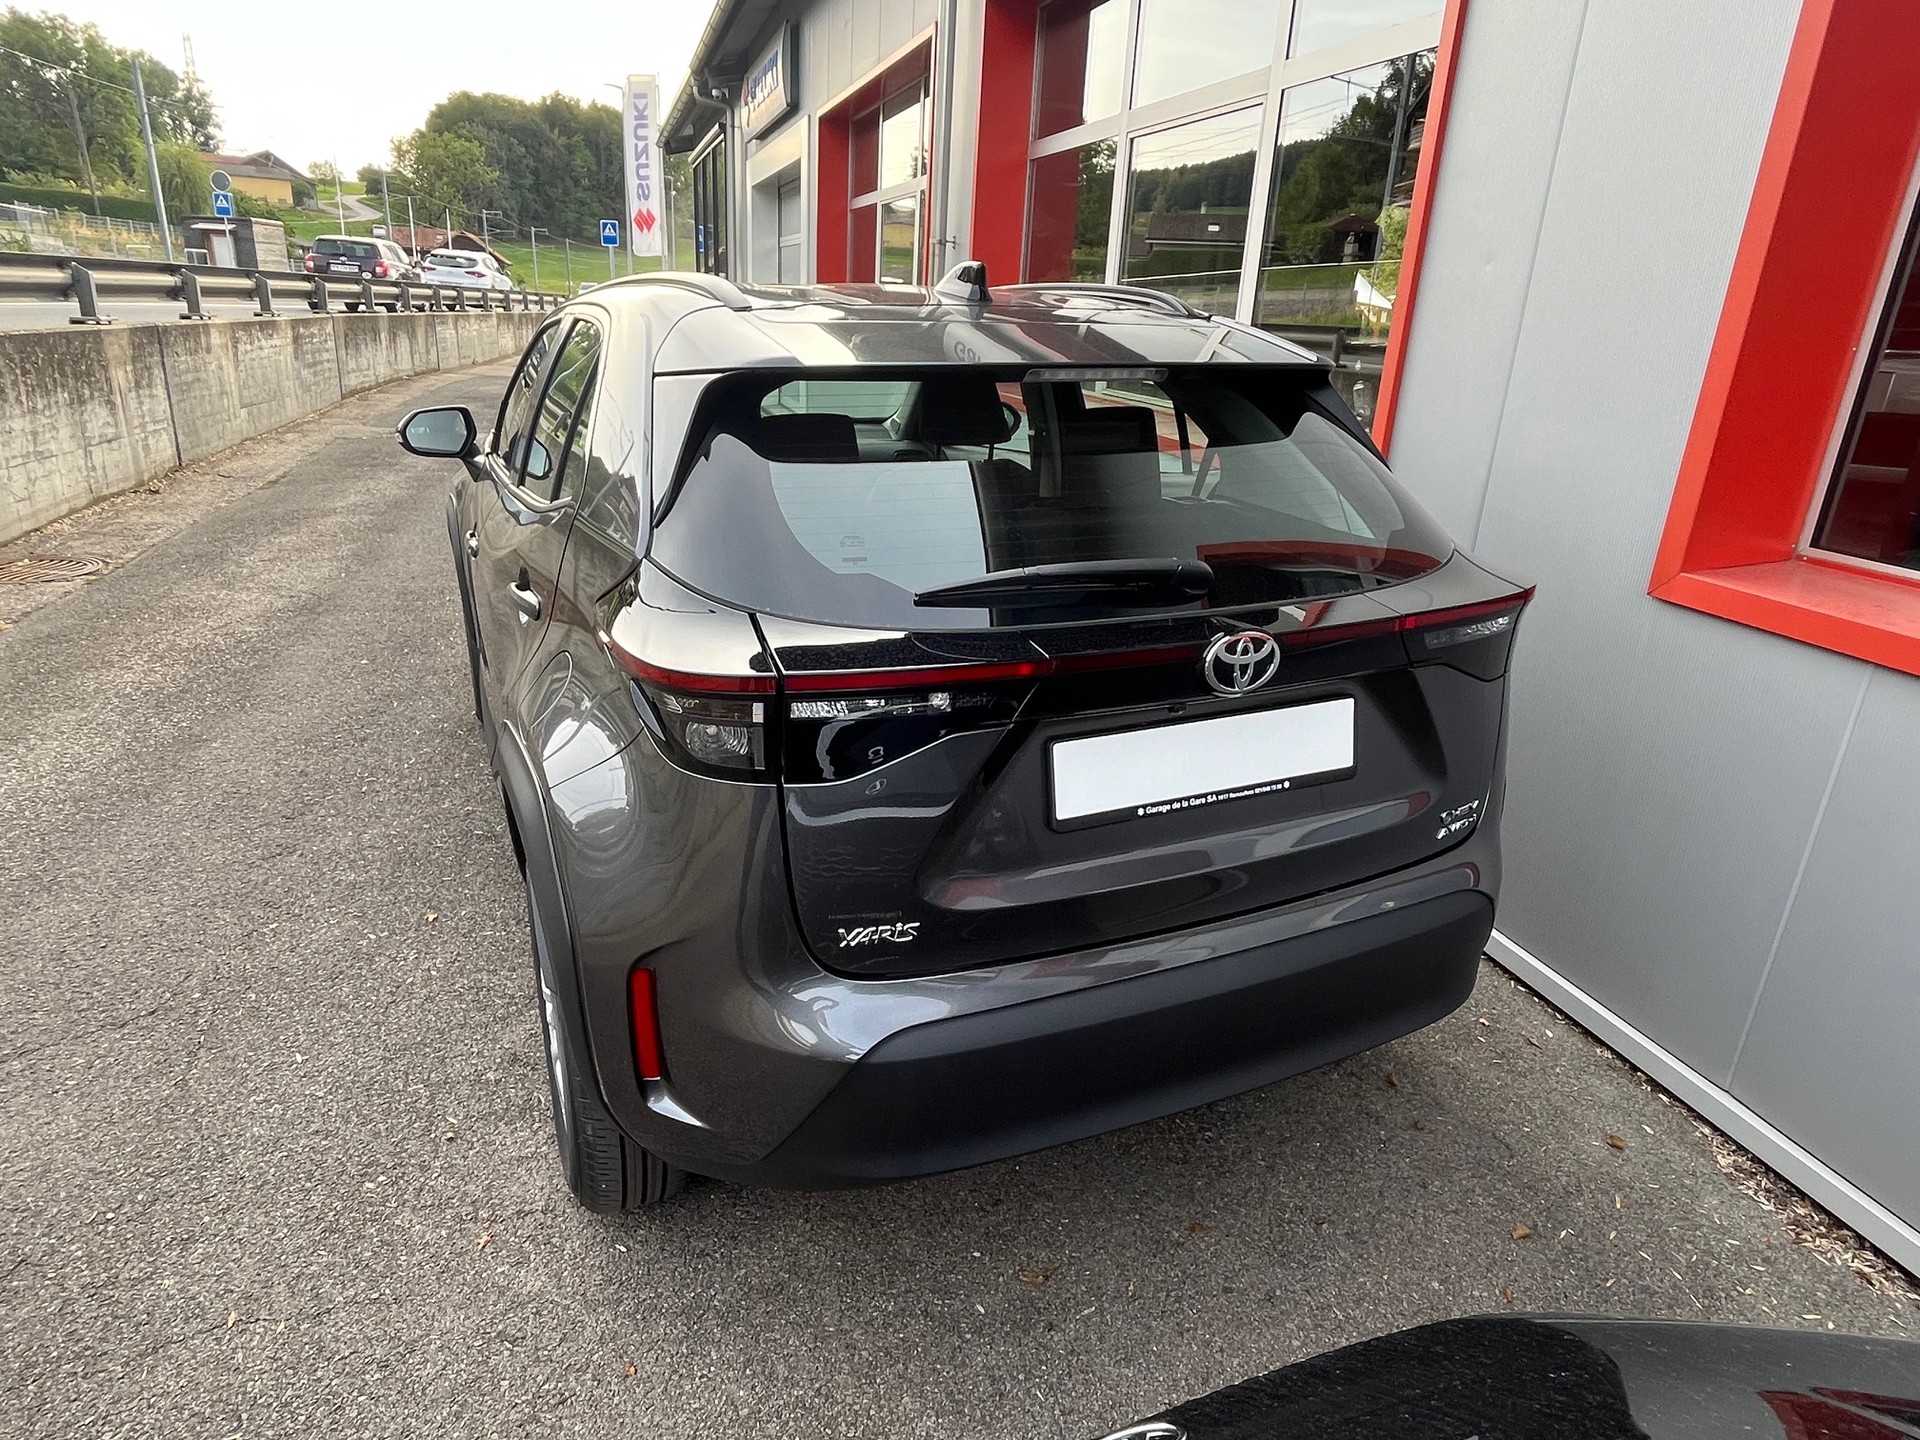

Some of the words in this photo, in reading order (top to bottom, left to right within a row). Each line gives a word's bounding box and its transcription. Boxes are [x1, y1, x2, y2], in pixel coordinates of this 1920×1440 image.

[1145, 803, 1171, 814] Garage
[1171, 801, 1181, 810] de
[1181, 799, 1189, 808] la
[1189, 797, 1206, 806] Gare
[1206, 793, 1218, 803] SA
[838, 922, 920, 947] YARIS
